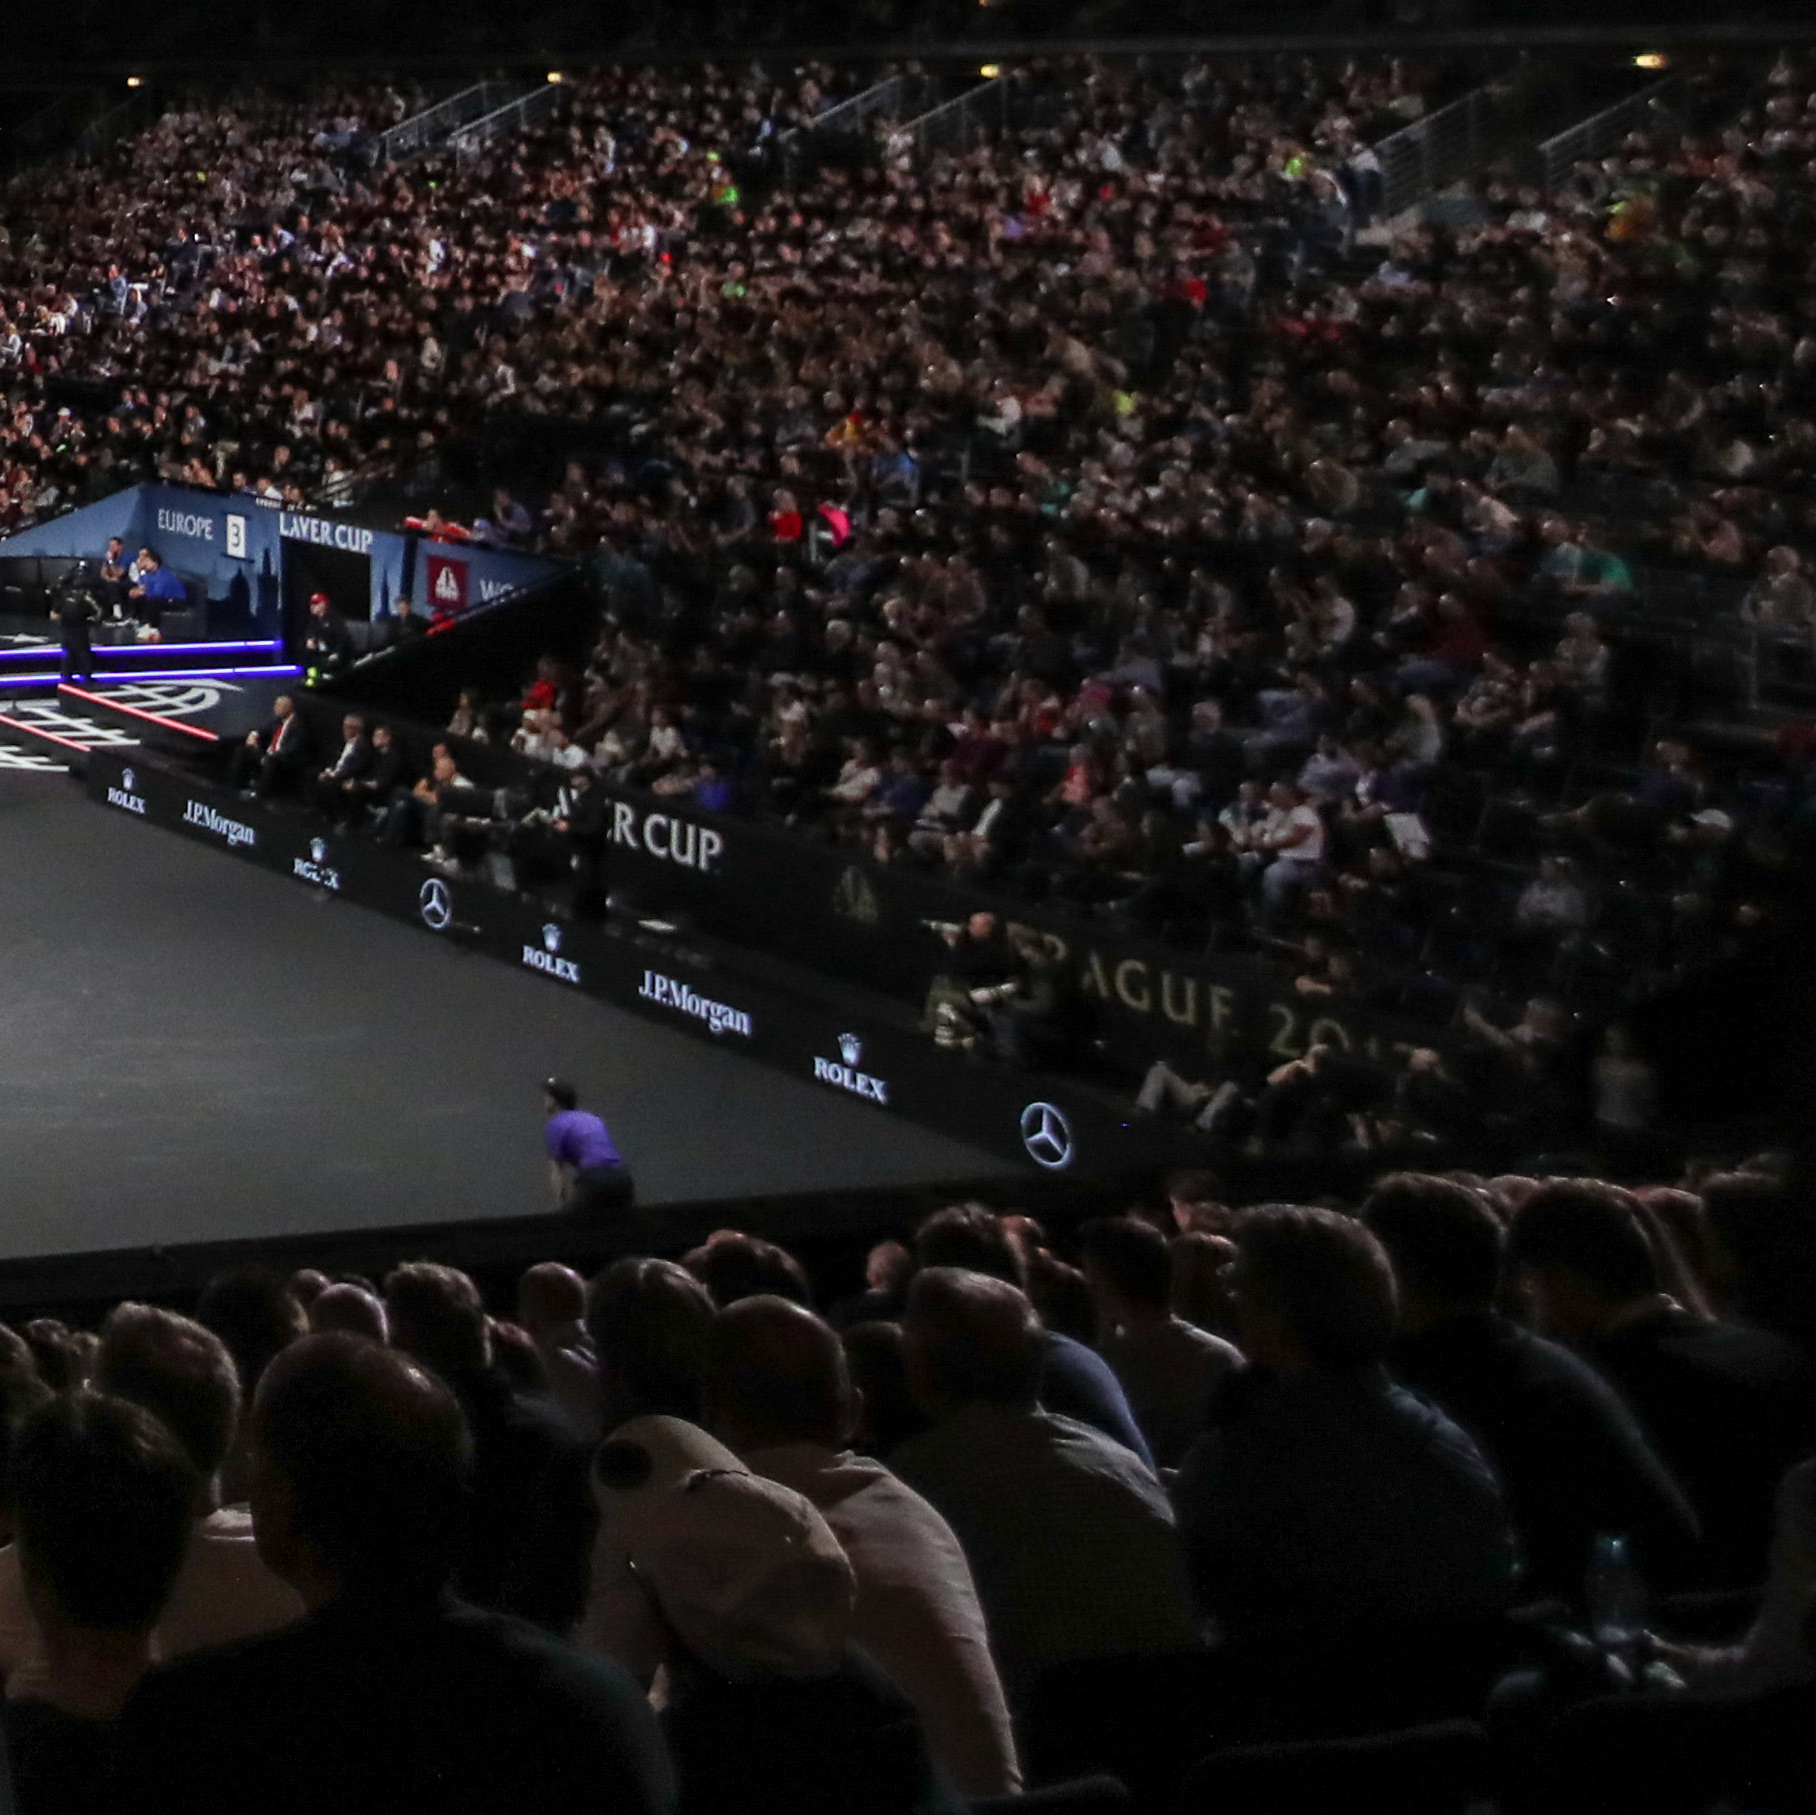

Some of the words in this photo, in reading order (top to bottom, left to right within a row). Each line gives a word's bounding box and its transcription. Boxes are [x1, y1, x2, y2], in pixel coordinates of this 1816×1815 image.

[157, 509, 214, 540] EUROPE
[229, 522, 243, 549] 3
[279, 513, 334, 545] LAVER
[335, 525, 374, 553] CUP
[107, 787, 146, 815] ROLEX
[183, 800, 255, 846] J.P.Morgan
[643, 813, 724, 872] CUP
[293, 858, 340, 890] ROLX
[523, 944, 580, 982] ROLEX
[638, 969, 752, 1038] J.P.Morgan
[813, 1056, 889, 1105] ROLEX
